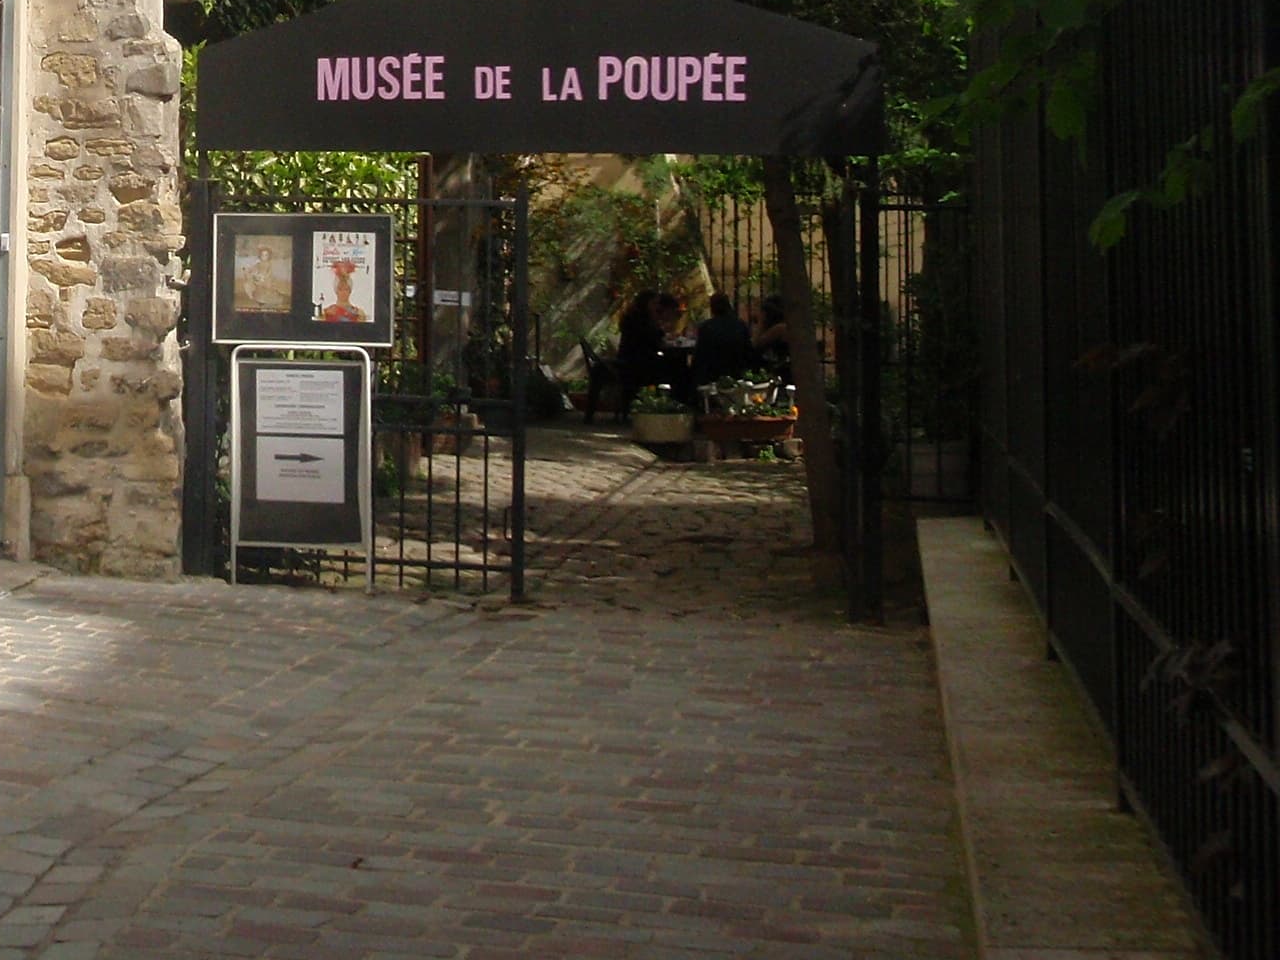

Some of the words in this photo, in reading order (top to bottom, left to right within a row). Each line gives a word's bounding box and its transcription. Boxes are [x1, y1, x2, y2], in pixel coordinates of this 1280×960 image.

[316, 52, 444, 101] MUSÉE
[474, 65, 511, 99] DE
[542, 67, 583, 100] LA
[598, 52, 746, 101] POUPÉE
